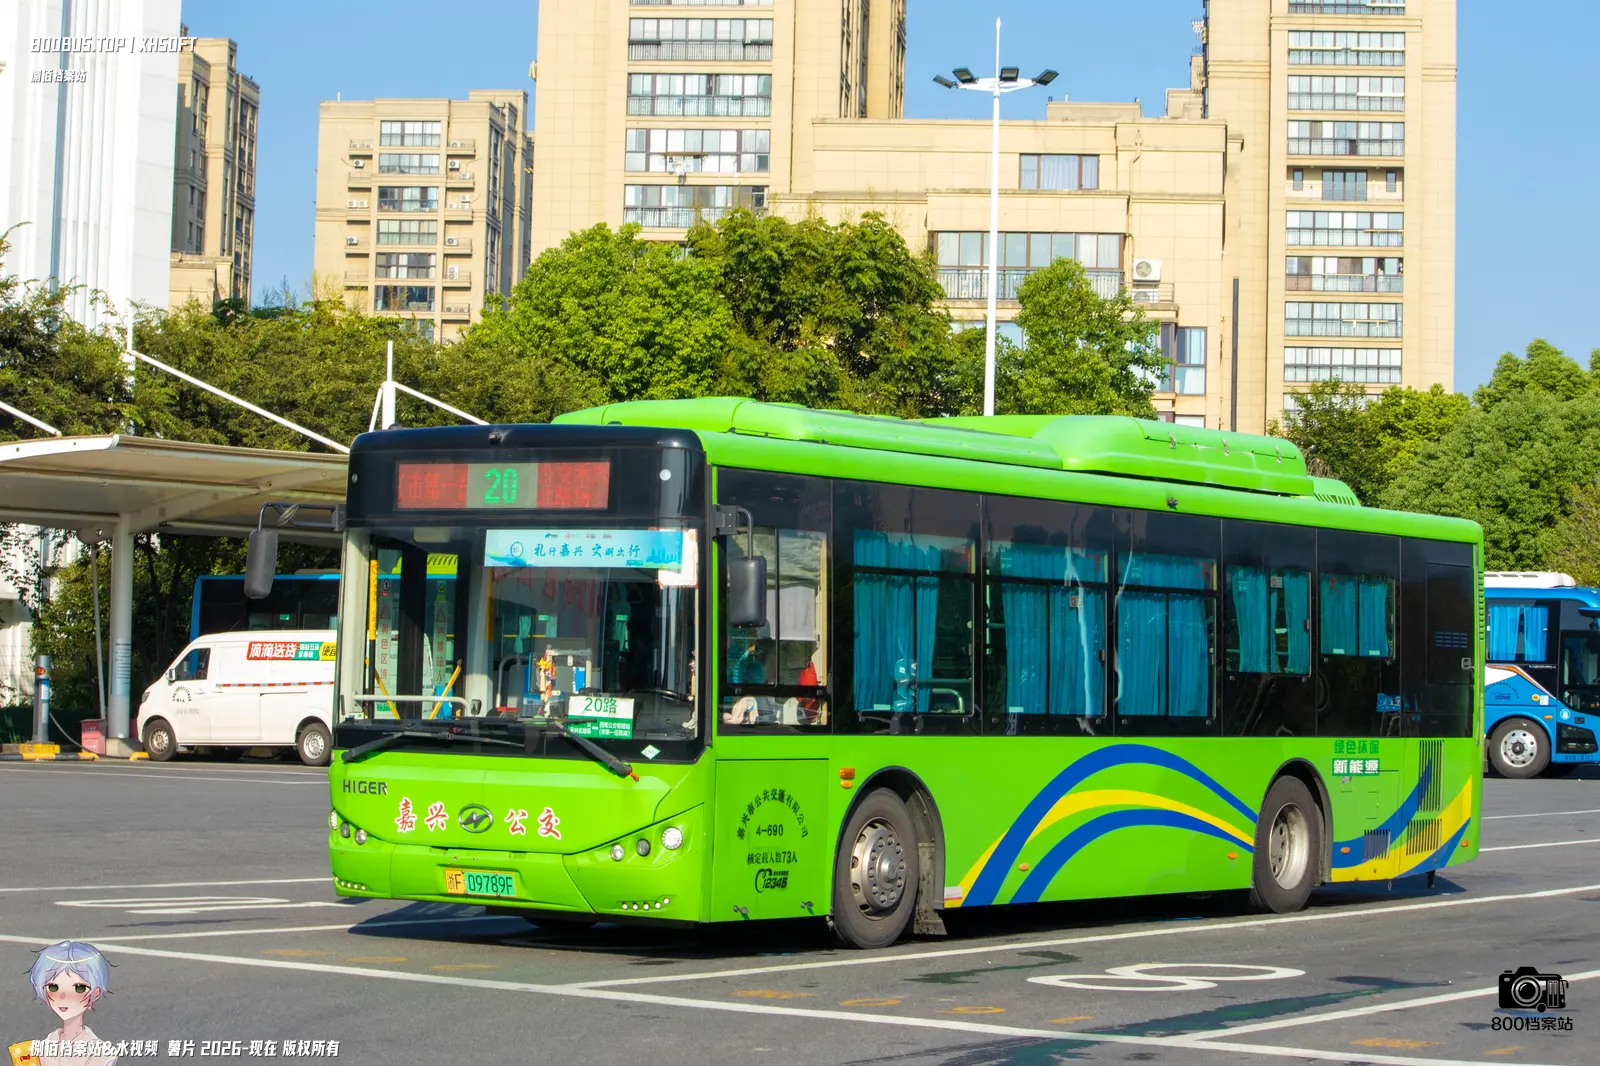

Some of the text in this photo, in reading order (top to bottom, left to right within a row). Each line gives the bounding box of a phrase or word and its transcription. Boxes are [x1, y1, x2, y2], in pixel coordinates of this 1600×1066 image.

[484, 468, 518, 504] 20
[584, 697, 617, 714] 20路
[1334, 739, 1380, 754] 绿色环保
[1333, 759, 1379, 774] 新能源
[343, 779, 388, 795] HIGER
[755, 824, 784, 837] 4-690
[762, 877, 788, 889] 12345
